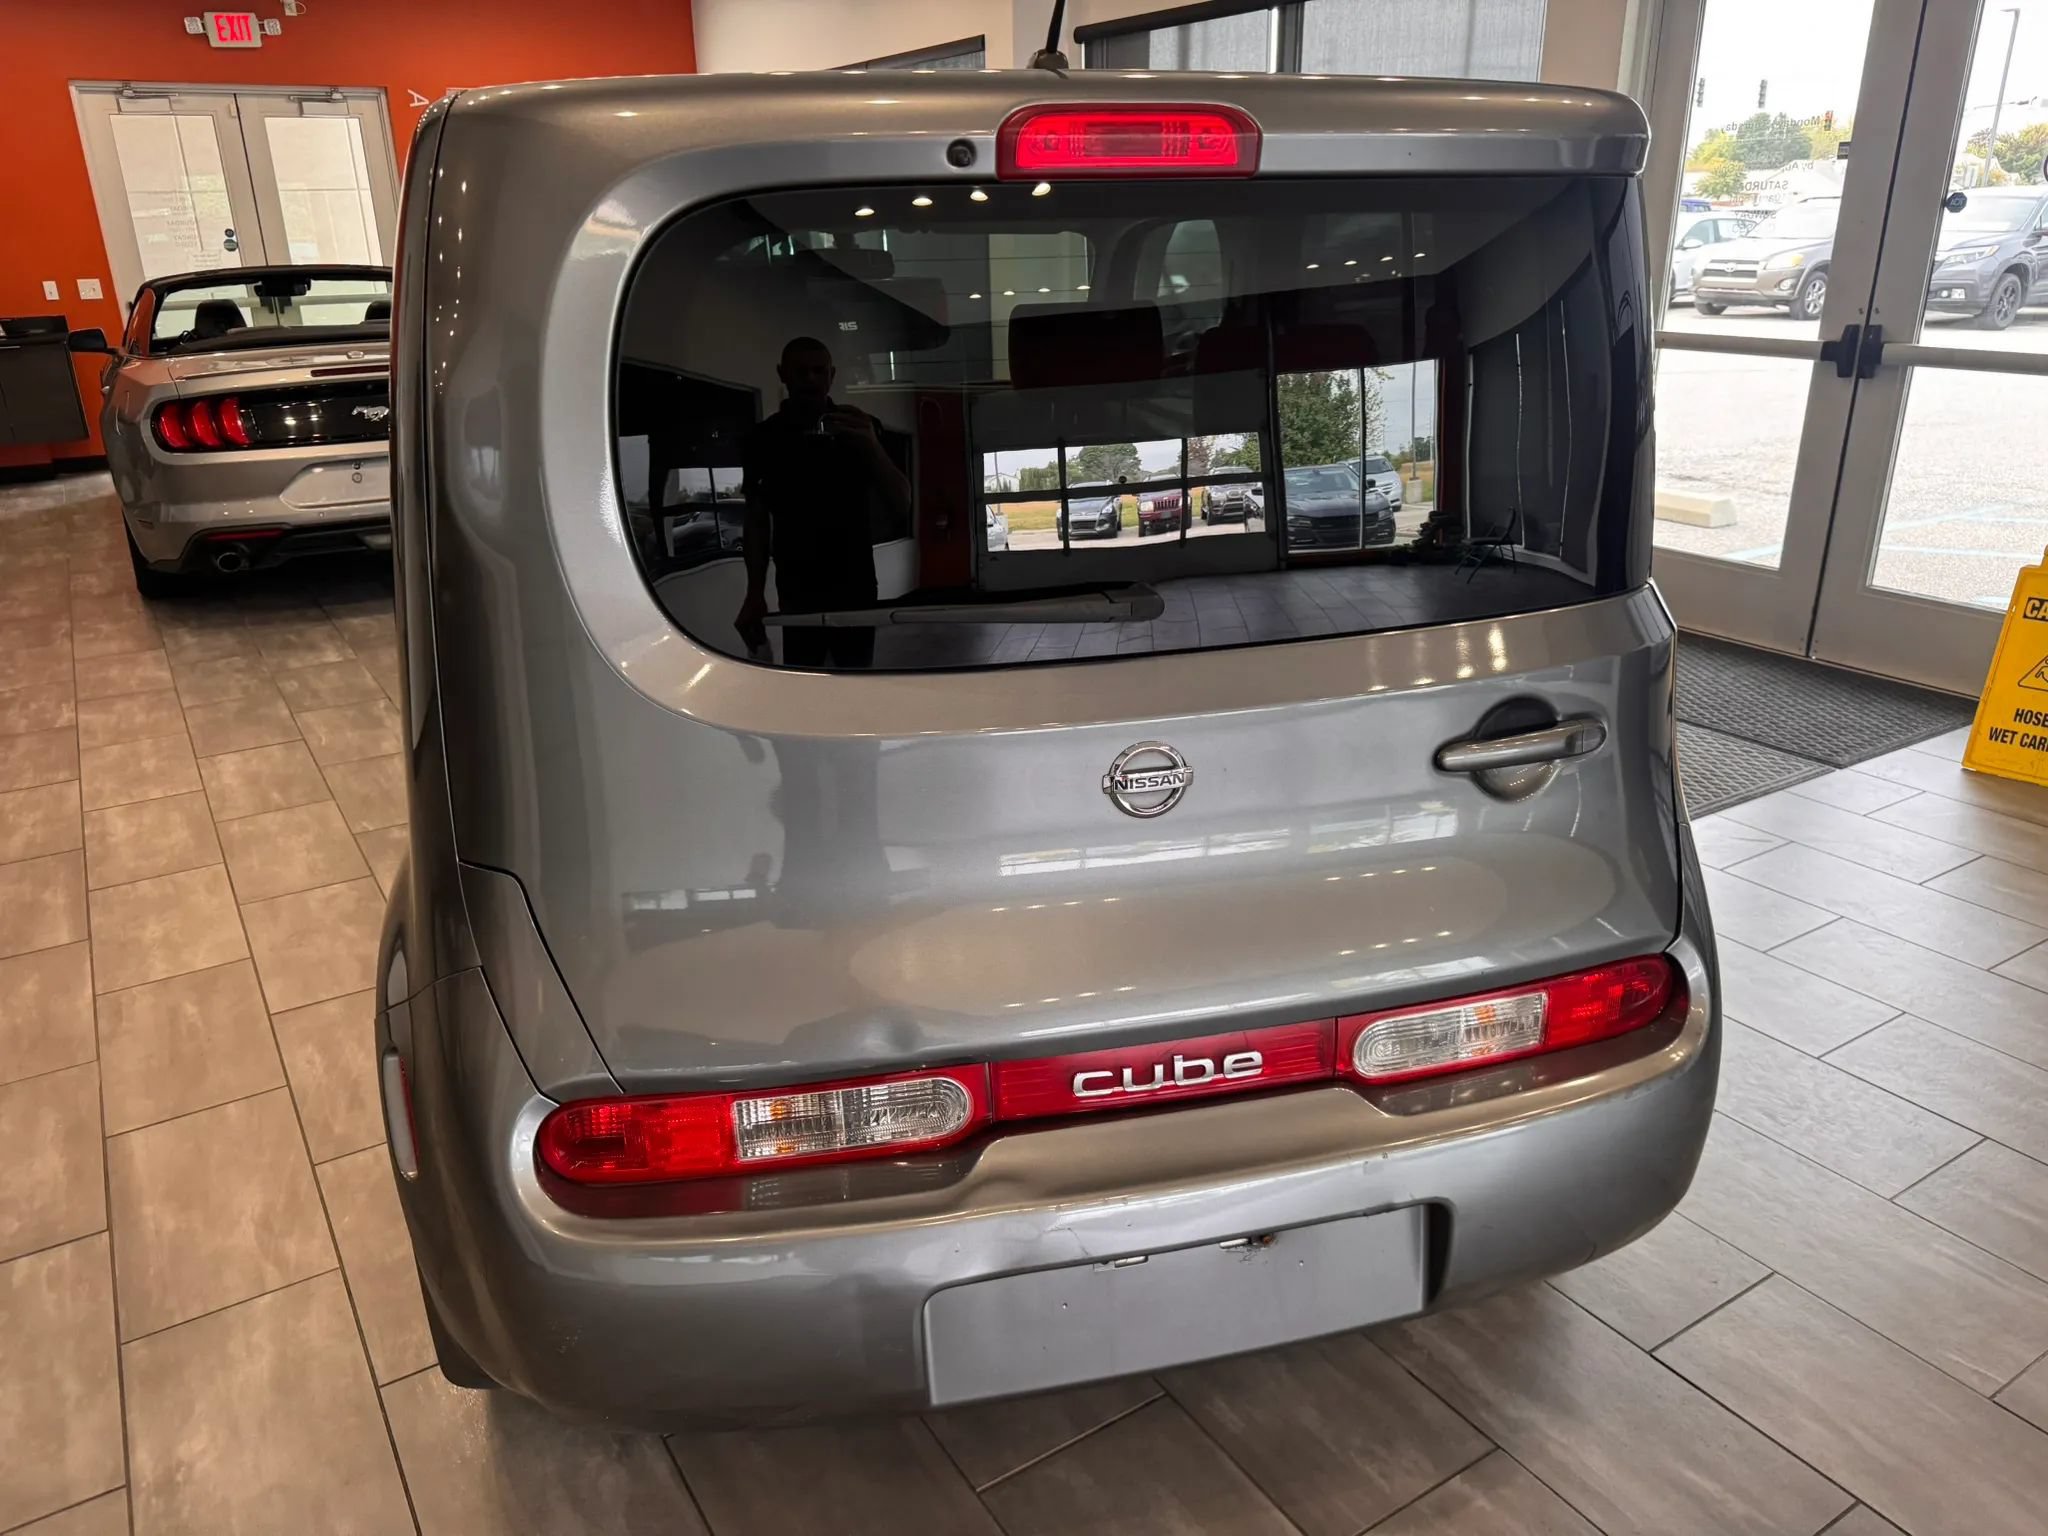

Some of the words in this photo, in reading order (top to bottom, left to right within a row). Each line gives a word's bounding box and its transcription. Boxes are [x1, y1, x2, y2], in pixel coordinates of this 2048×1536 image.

[213, 14, 253, 42] EXIT
[1989, 726, 2018, 745] WET
[2019, 732, 2048, 752] CAR
[1114, 772, 1185, 791] NISSAN
[1073, 1050, 1263, 1097] cube
